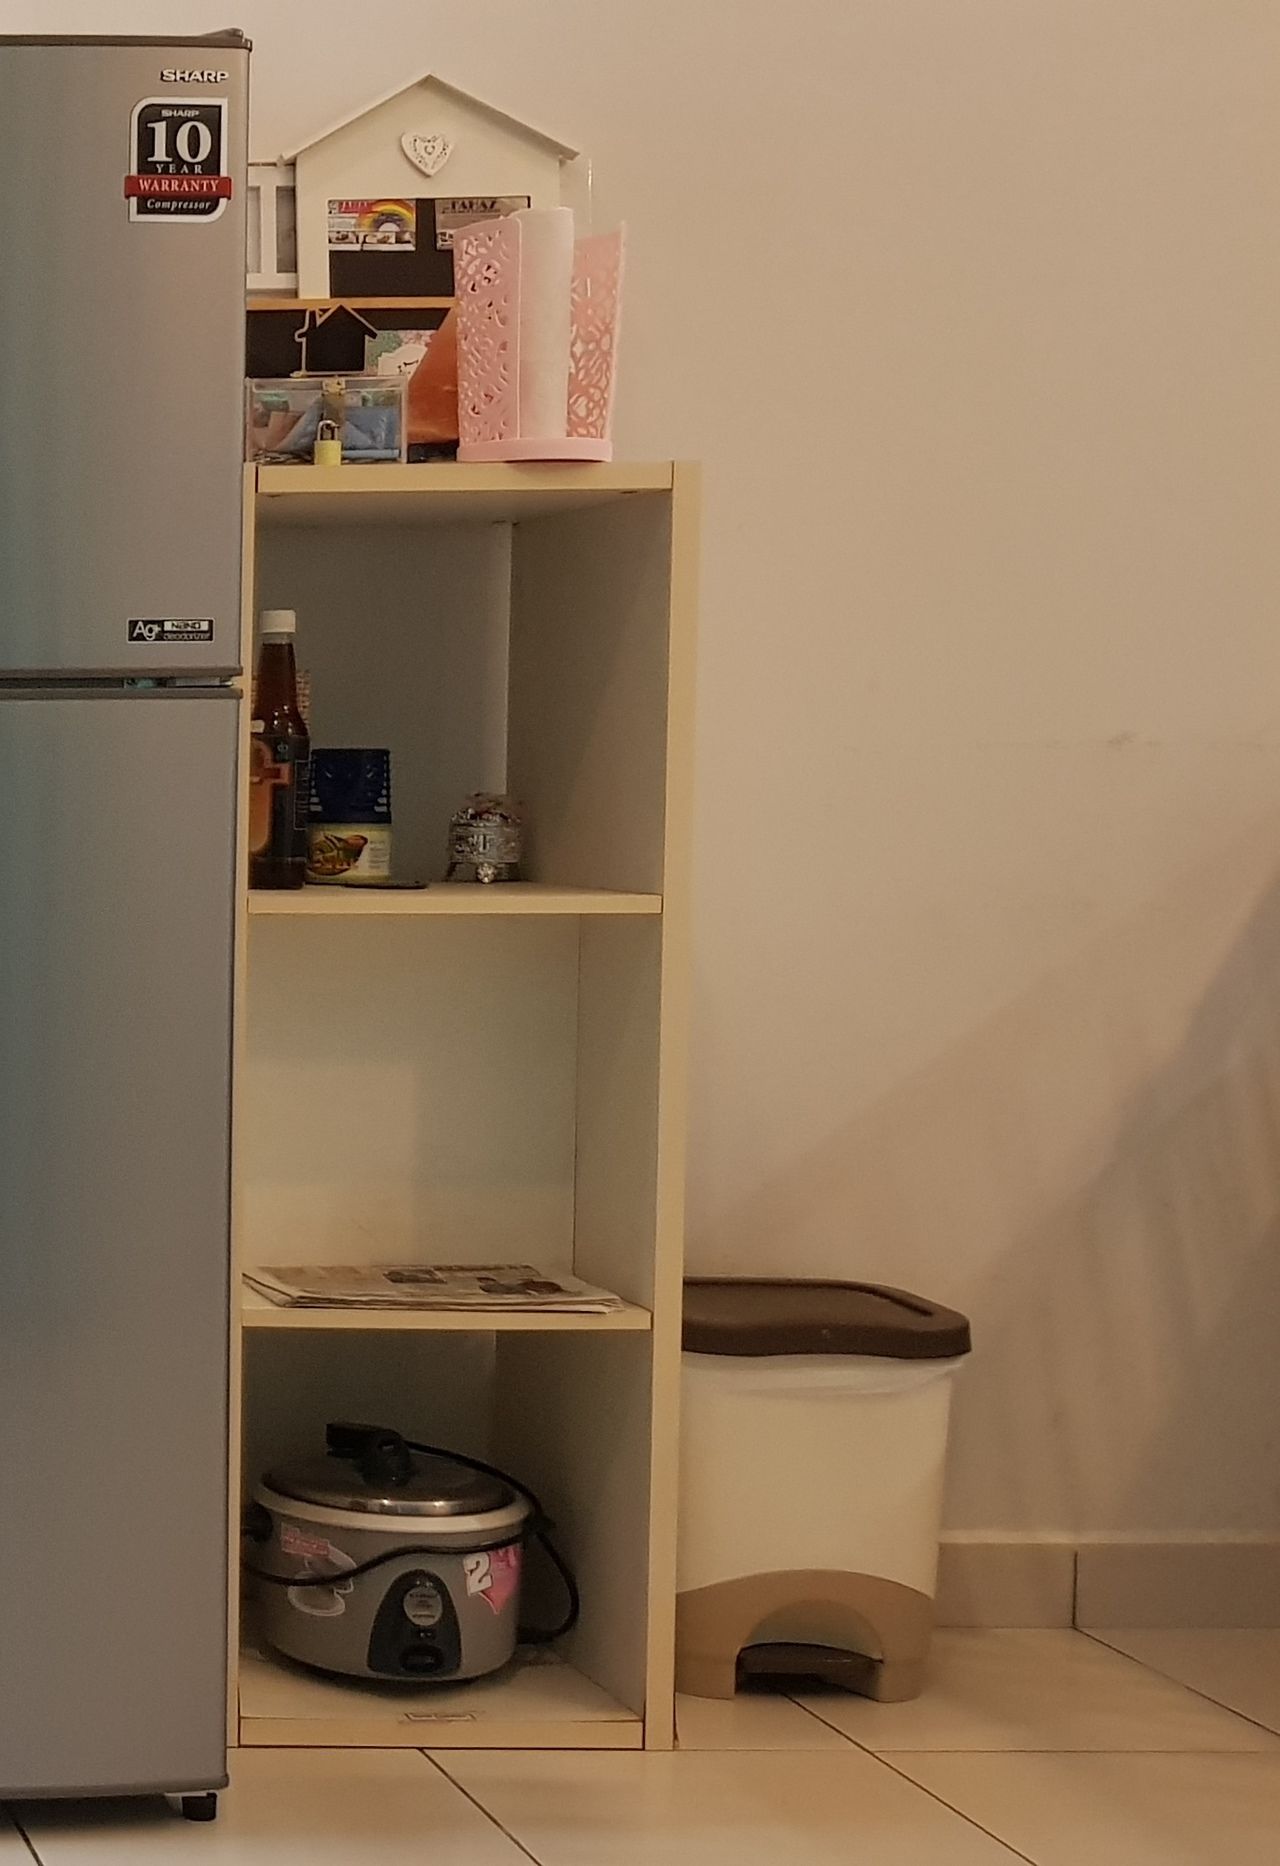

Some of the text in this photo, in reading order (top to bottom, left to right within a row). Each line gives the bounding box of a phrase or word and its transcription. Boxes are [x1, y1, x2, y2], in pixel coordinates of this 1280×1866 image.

[161, 69, 230, 82] SHARP
[161, 109, 200, 117] SHARP
[146, 120, 212, 163] 10
[156, 164, 203, 173] YEAR
[139, 178, 219, 192] WARRANTY
[146, 199, 211, 211] Compressor
